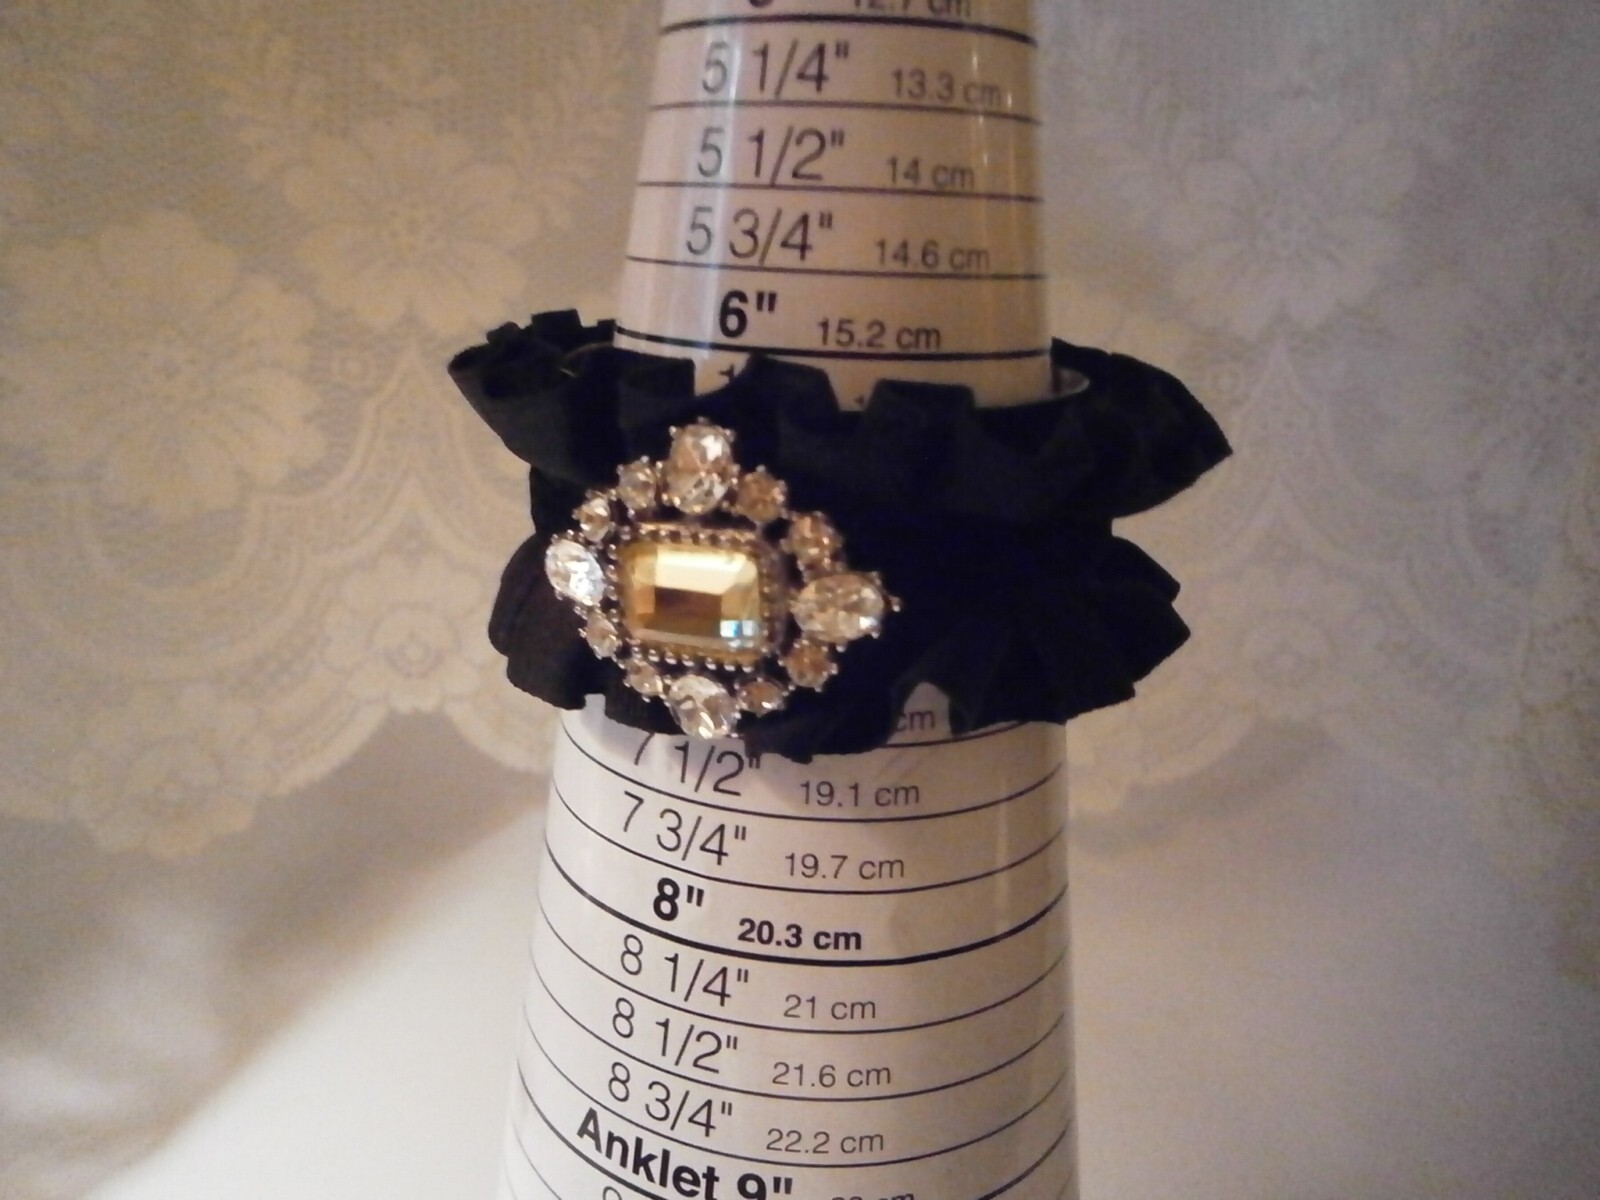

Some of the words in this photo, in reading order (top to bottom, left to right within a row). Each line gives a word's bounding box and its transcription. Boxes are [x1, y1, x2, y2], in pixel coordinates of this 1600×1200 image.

[928, 0, 971, 17] cm
[701, 41, 729, 94] 5
[752, 38, 849, 98] 1/4"
[893, 69, 955, 101] 13.3
[962, 78, 1002, 105] cm
[696, 127, 723, 178] 5
[747, 125, 845, 184] 1/2"
[886, 157, 925, 186] 14
[932, 162, 975, 188] cm
[686, 205, 713, 256] 5
[729, 208, 833, 267] 3/4"
[875, 240, 938, 269] 14.6
[948, 246, 990, 270] cm
[719, 290, 777, 338] 6"
[818, 319, 885, 348] 15.2
[896, 326, 941, 350] cm
[675, 740, 761, 797] 1/2"
[800, 781, 864, 808] 19.1
[874, 784, 920, 808] cm
[620, 791, 644, 833] 7
[656, 809, 747, 866] 3/4"
[785, 853, 848, 879] 19.7
[859, 855, 905, 880] cm
[653, 877, 705, 922] 8"
[738, 917, 803, 947] 20.3
[813, 928, 862, 951] cm
[620, 935, 644, 975] 8
[664, 953, 749, 1007] 1/4"
[784, 995, 819, 1018] 21
[831, 997, 877, 1020] cm
[612, 998, 636, 1039] 8
[655, 1018, 738, 1073] 1/2"
[773, 1062, 836, 1088] 21.6
[847, 1062, 891, 1088] cm
[608, 1062, 631, 1103] 8
[644, 1081, 733, 1137] 3/4"
[576, 1107, 720, 1200] Anklet
[766, 1128, 830, 1154] 22.2
[840, 1129, 884, 1154] cm
